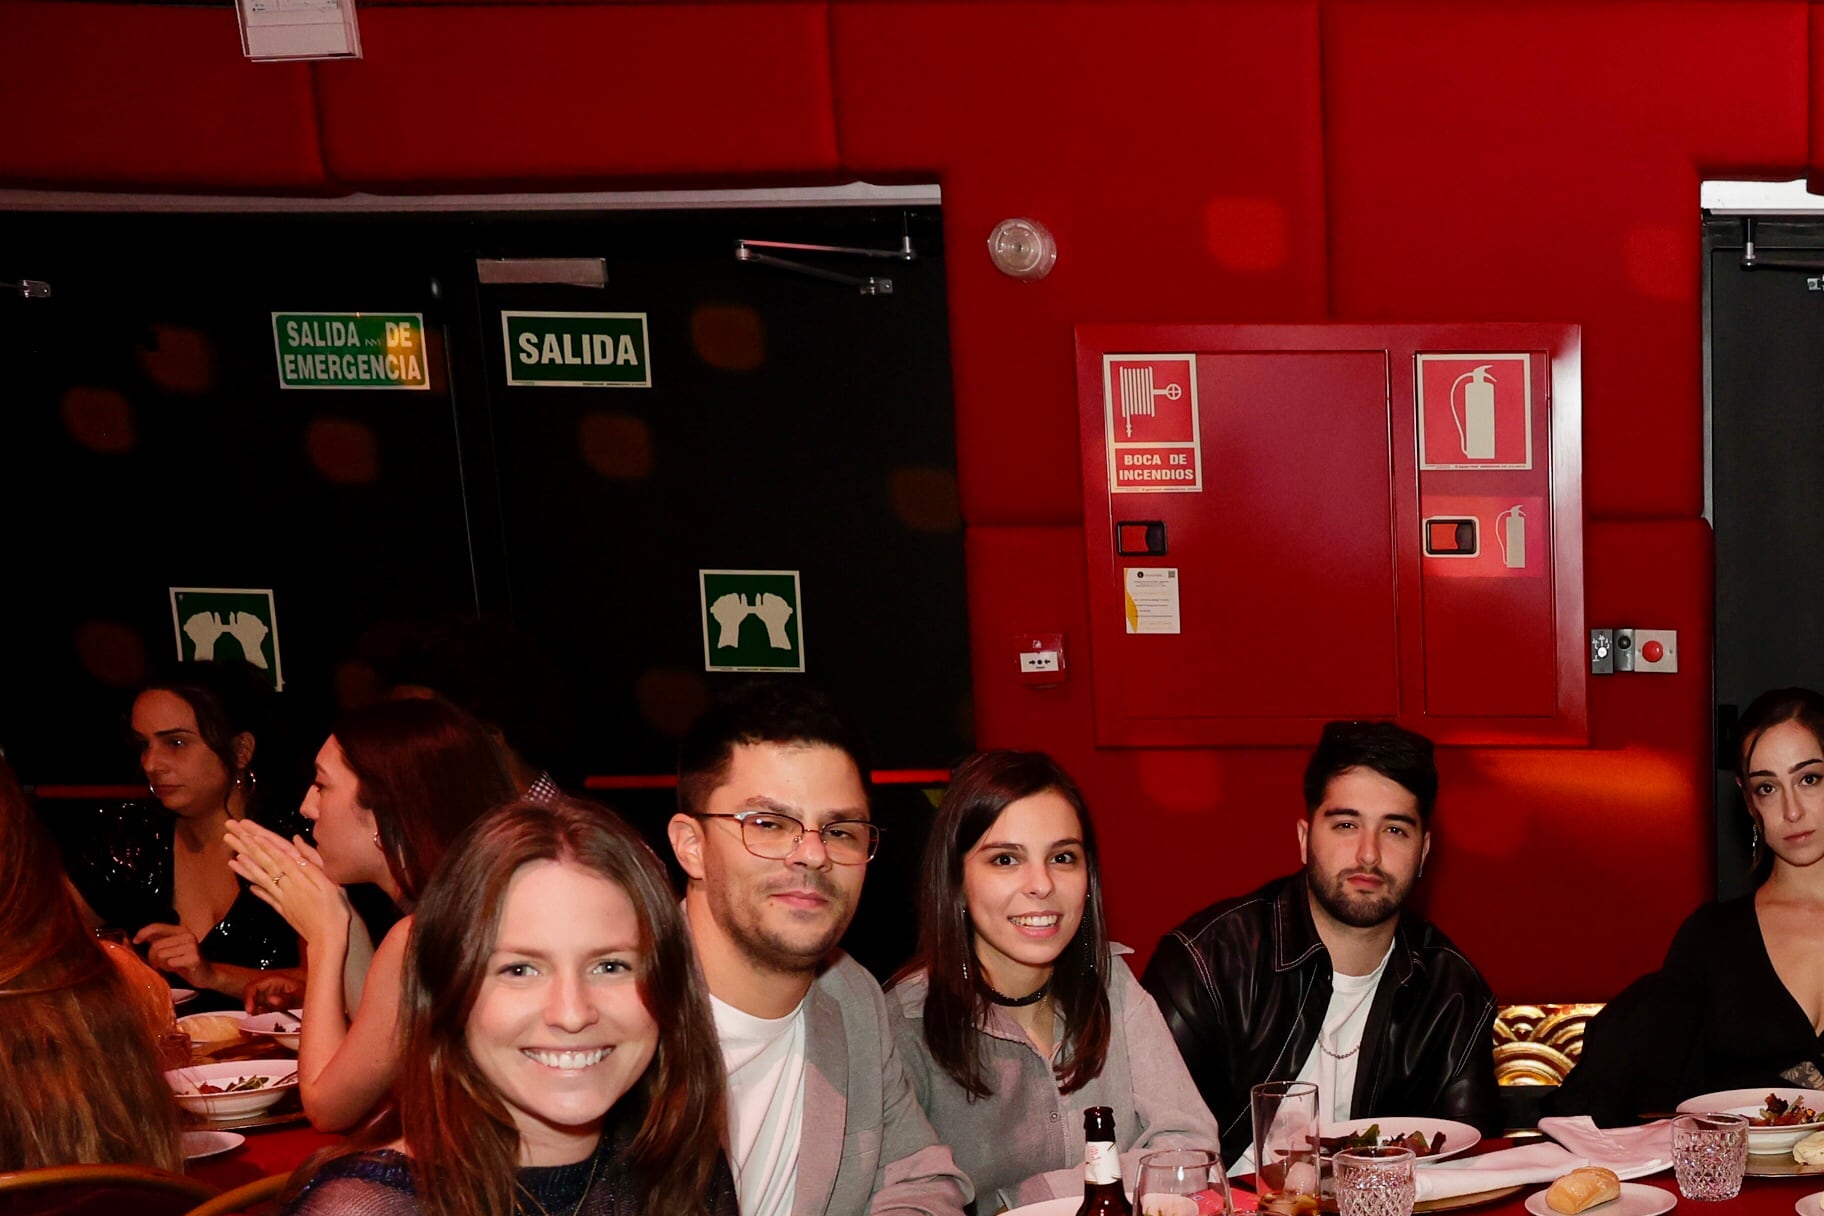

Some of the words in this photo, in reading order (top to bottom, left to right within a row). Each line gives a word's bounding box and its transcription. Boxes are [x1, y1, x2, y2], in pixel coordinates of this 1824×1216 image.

[287, 321, 361, 348] SALIDA
[385, 321, 413, 348] DE
[518, 332, 639, 367] SALIDA
[284, 354, 422, 381] EMERGENCIA
[1123, 454, 1162, 466] BOCA
[1169, 453, 1187, 465] DE
[1119, 469, 1194, 481] INCENDIOS
